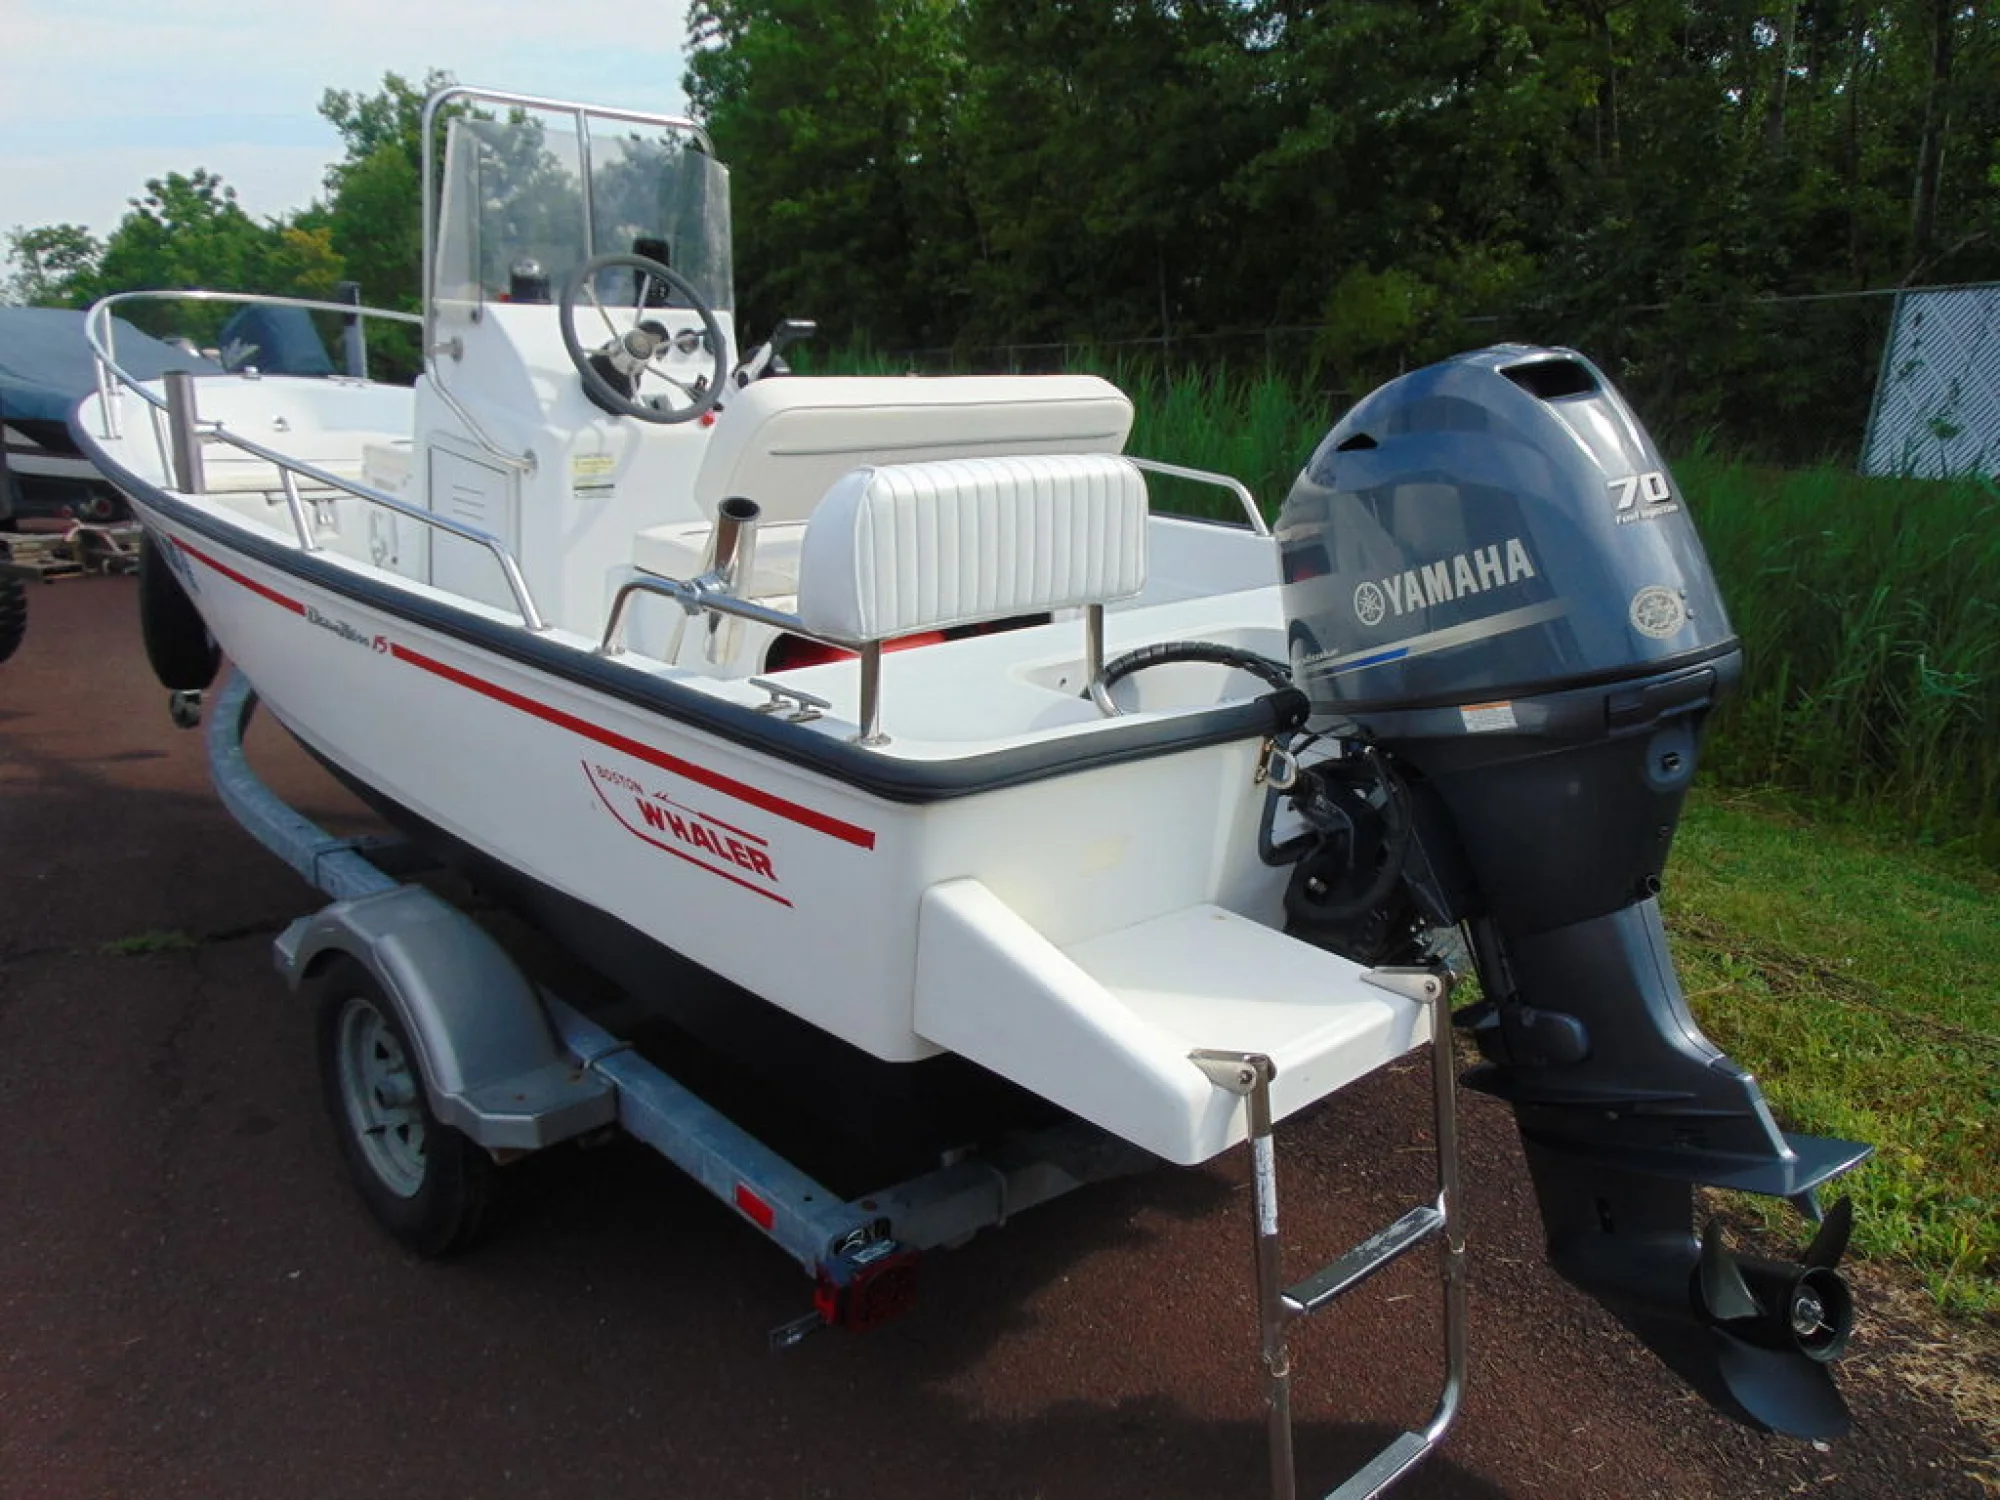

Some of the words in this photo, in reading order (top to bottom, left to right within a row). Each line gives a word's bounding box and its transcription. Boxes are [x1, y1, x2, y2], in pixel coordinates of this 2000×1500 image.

[1606, 472, 1670, 509] 70
[1382, 537, 1534, 616] YAMAHA
[634, 797, 778, 882] WHALER
